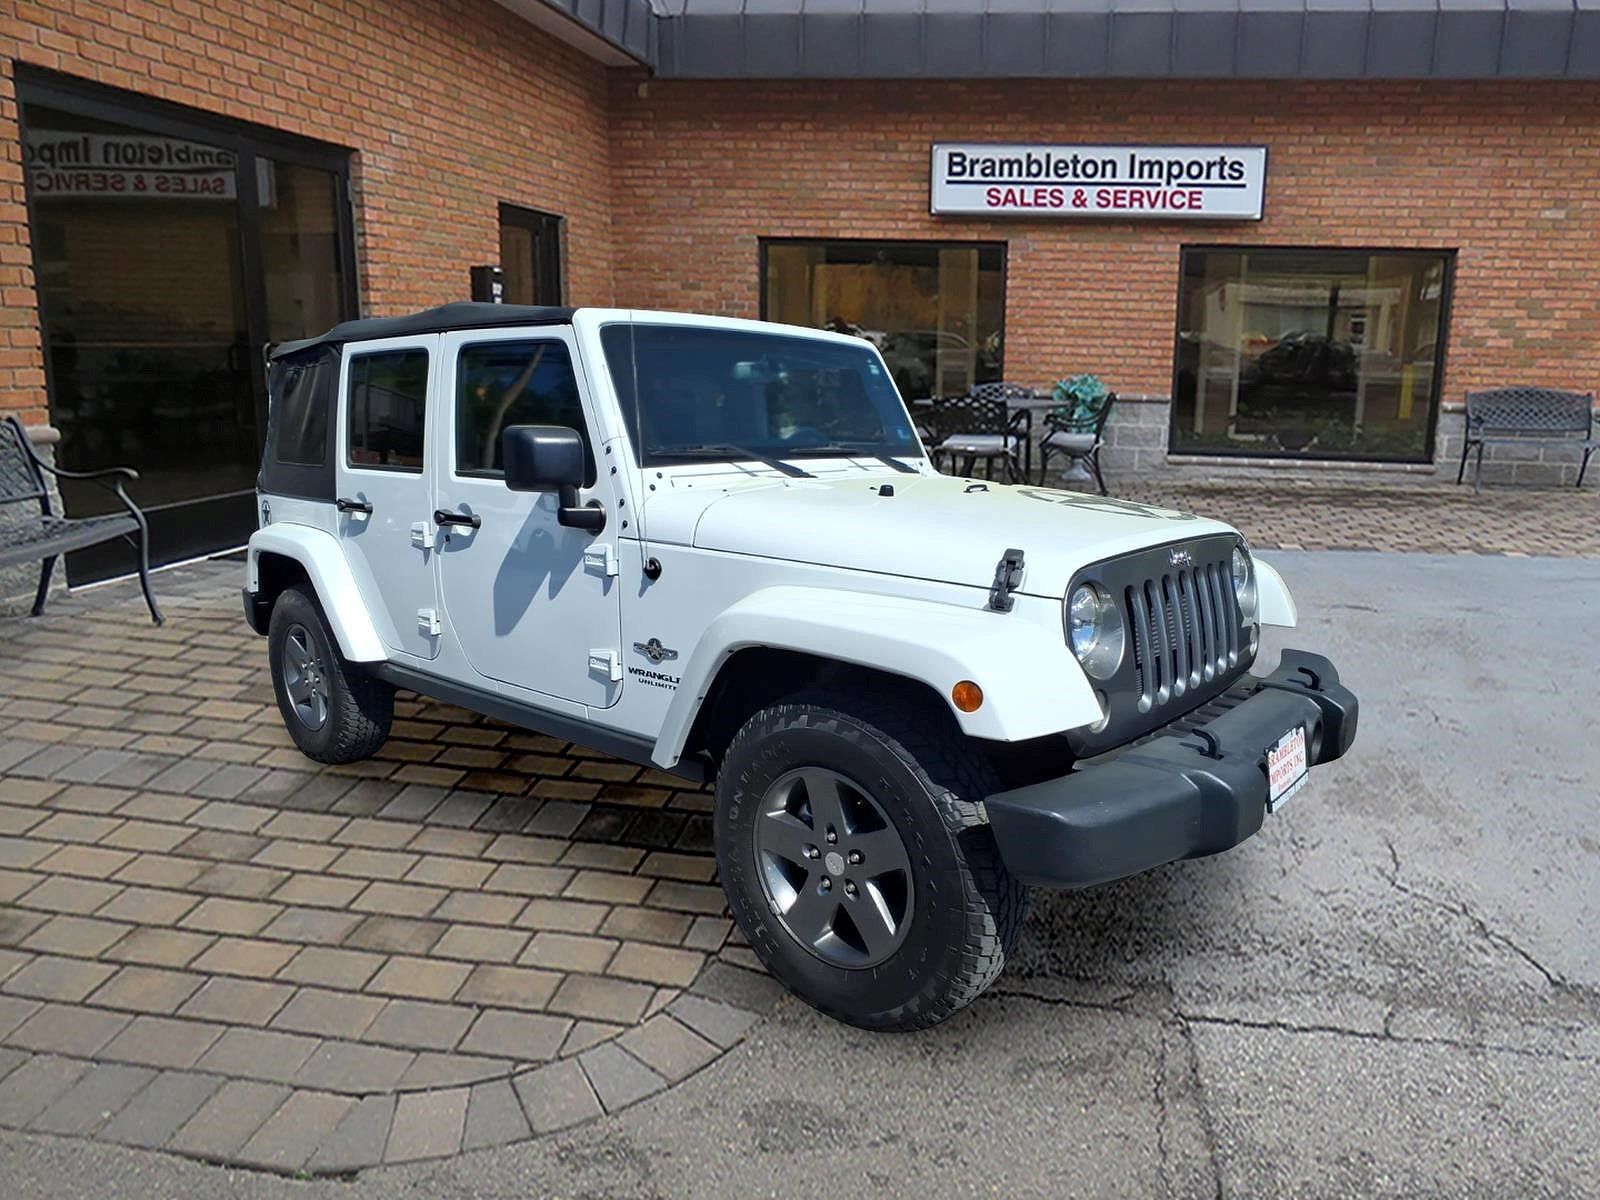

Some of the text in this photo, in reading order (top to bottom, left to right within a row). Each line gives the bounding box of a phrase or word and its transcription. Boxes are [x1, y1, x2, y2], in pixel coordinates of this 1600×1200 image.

[947, 152, 1246, 188] Brambleton Imports
[986, 187, 1203, 210] SALES & SERVICE
